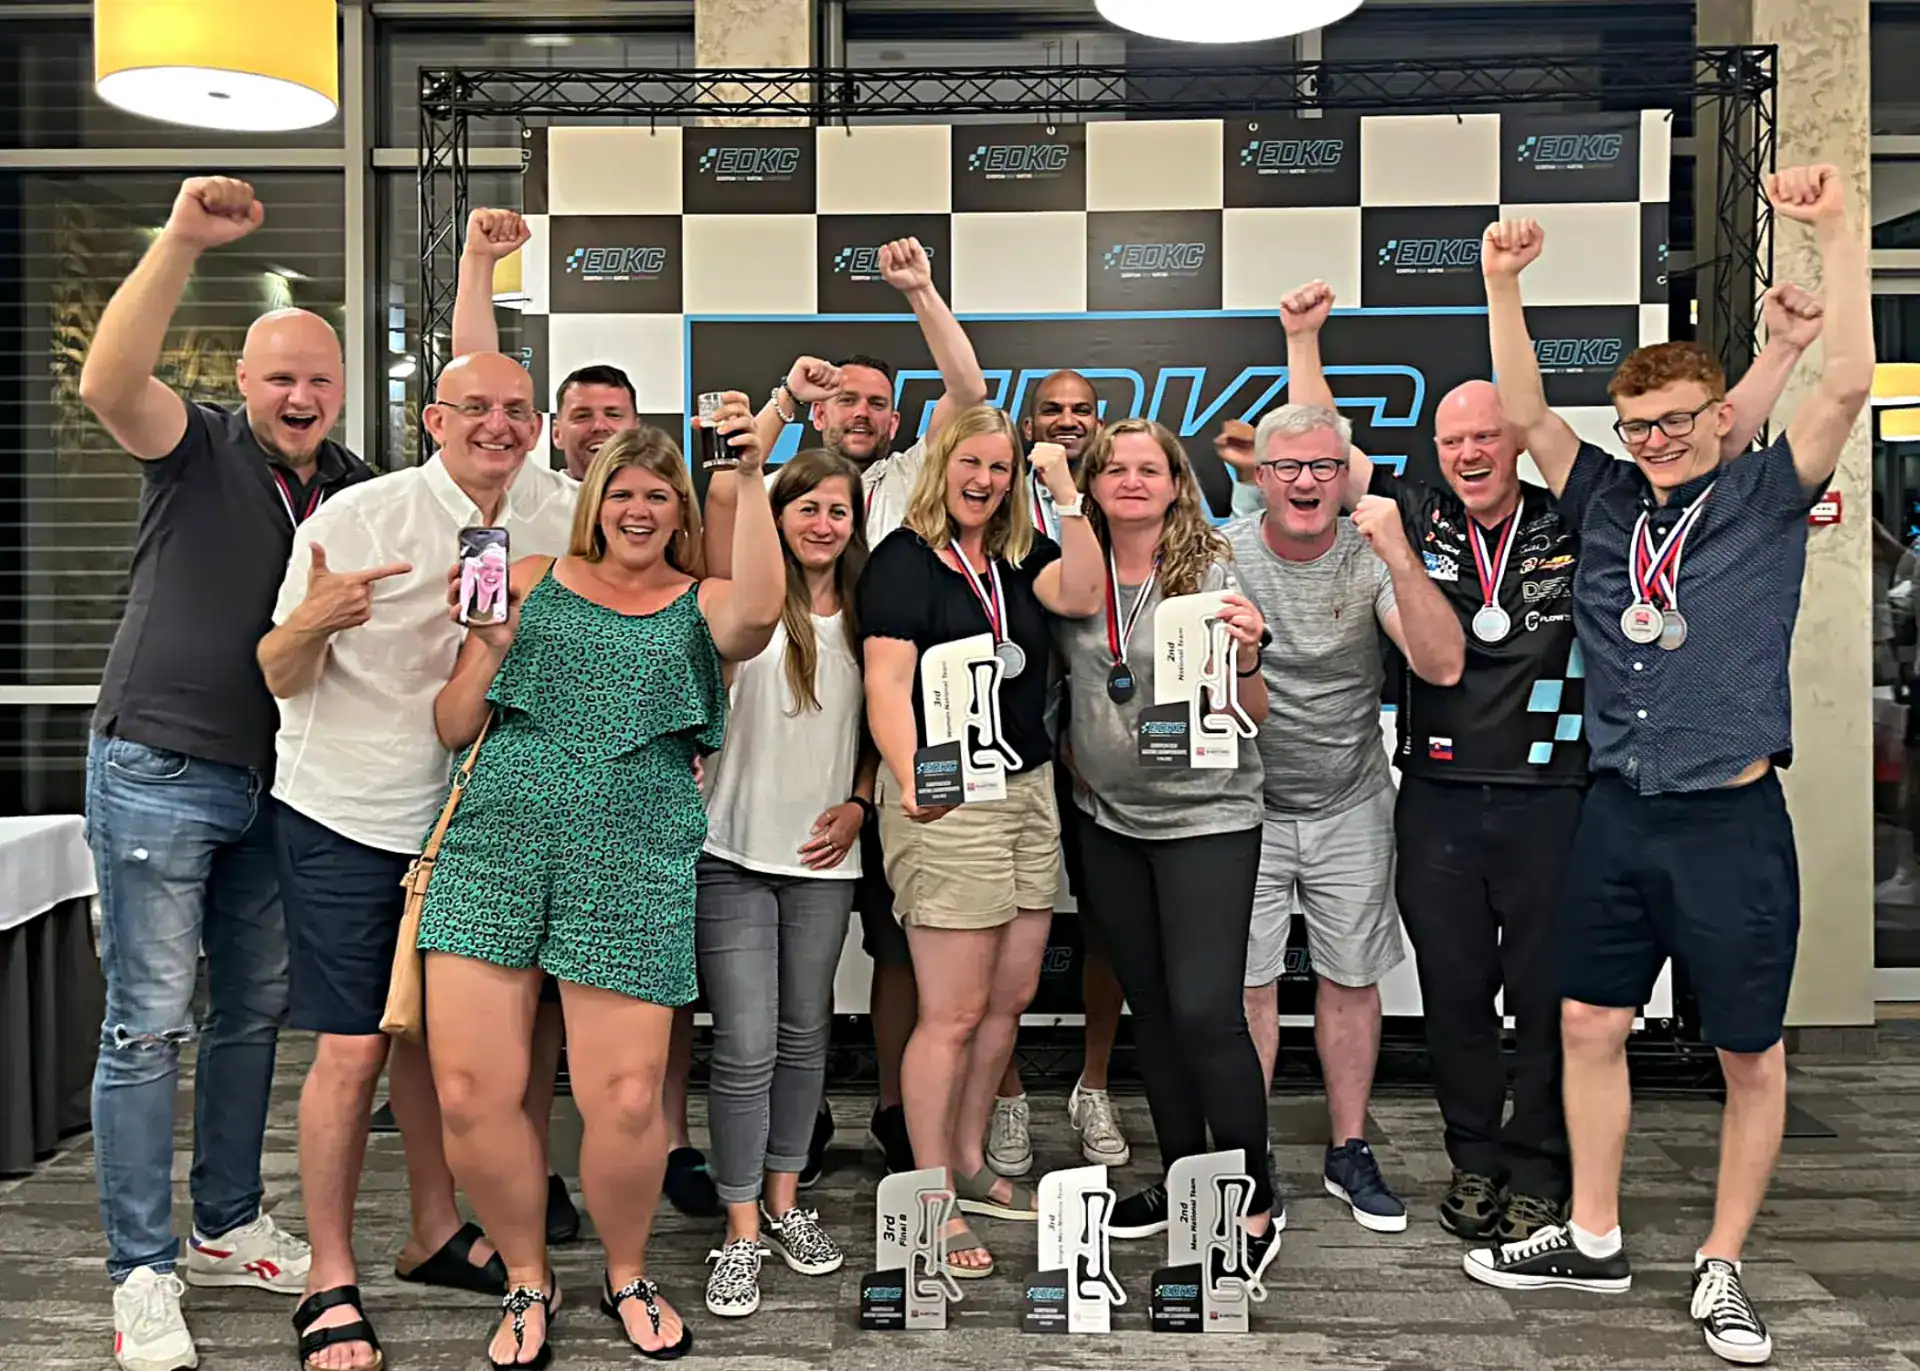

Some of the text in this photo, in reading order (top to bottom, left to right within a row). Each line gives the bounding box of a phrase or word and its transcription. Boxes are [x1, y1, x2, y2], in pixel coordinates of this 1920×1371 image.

[715, 148, 800, 173] EDKC
[984, 145, 1069, 171] EDKC
[1256, 140, 1343, 166] EDKC
[1533, 134, 1622, 161] EDKC
[581, 248, 666, 273] EDKC
[849, 246, 935, 273] ED
[1120, 243, 1206, 269] EDKC
[1395, 239, 1481, 266] EDKC
[1537, 338, 1622, 365] EDKC
[1166, 641, 1176, 662] 2nd
[932, 690, 942, 707] 3rd
[1048, 1213, 1056, 1232] 3rd
[1179, 1201, 1189, 1224] 2nd
[883, 1214, 896, 1242] 3rd
[899, 1223, 907, 1247] Final
